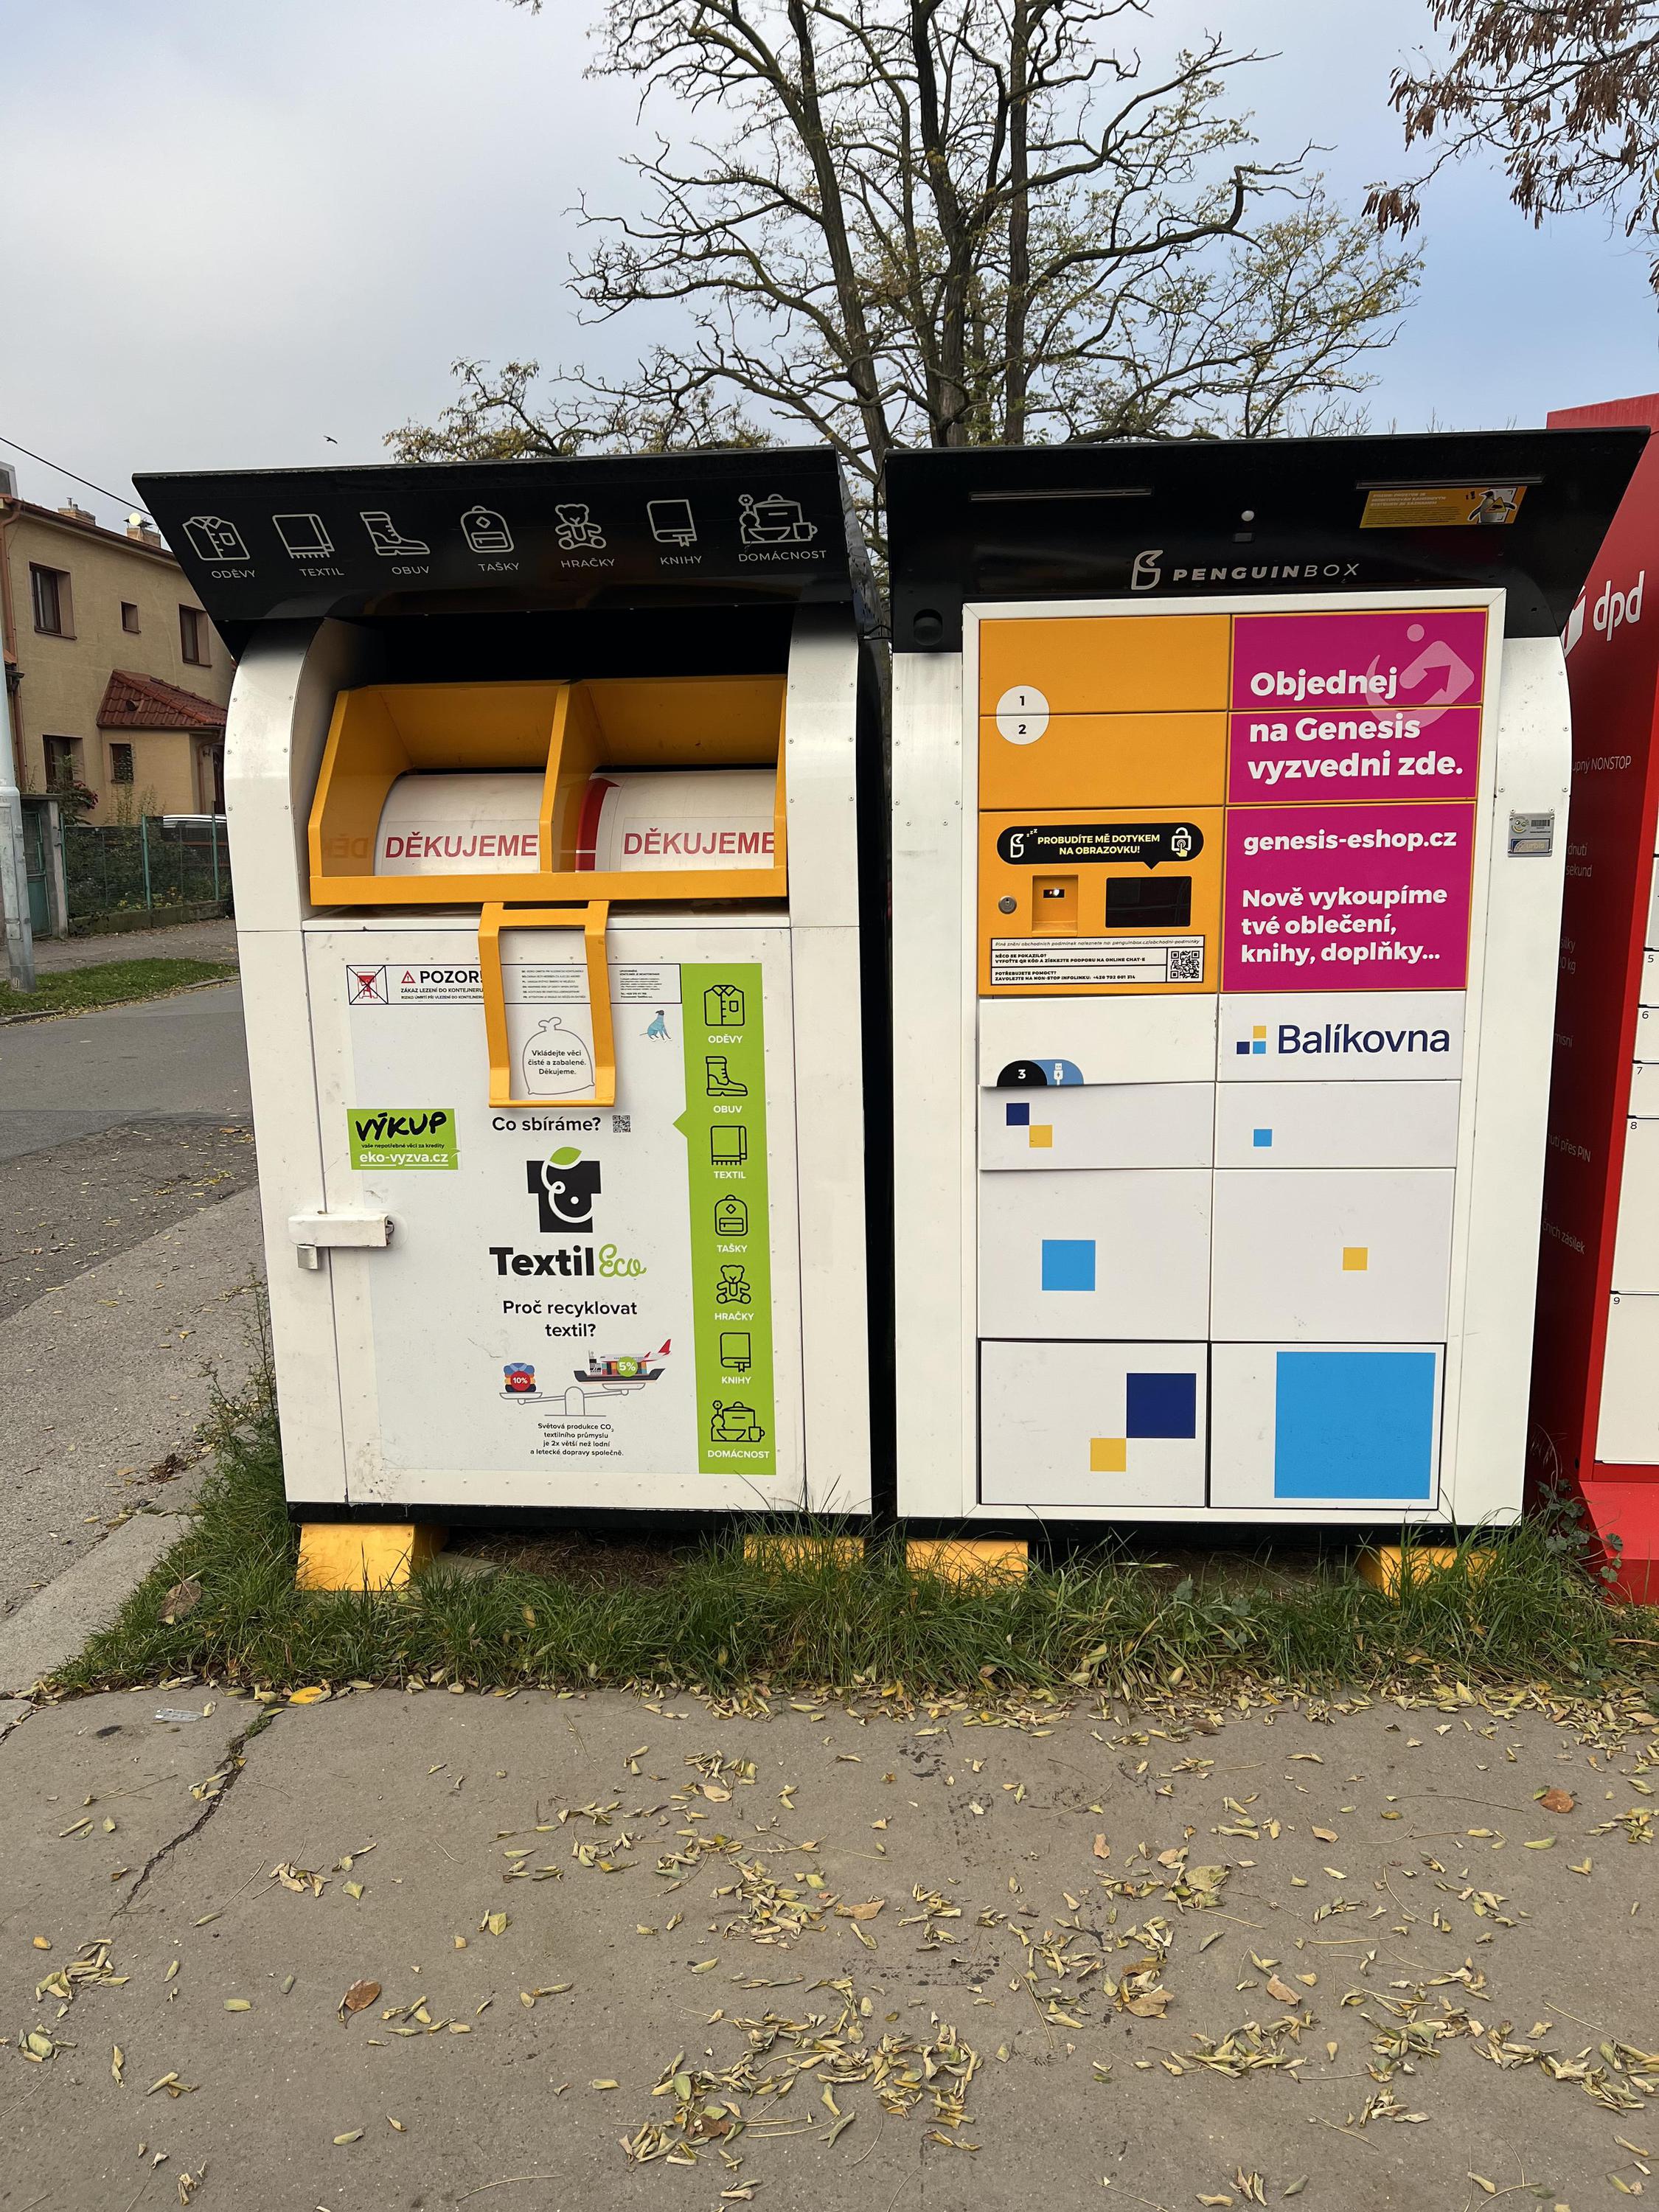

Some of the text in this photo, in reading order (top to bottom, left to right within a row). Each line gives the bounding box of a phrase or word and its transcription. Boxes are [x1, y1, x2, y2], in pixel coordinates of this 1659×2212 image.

[660, 555, 703, 566] KNIHY
[738, 548, 827, 563] DOMÁCNOST
[478, 560, 519, 572] TAŠKY
[560, 557, 616, 569] HRAČKY
[211, 568, 256, 579] ODĚVY
[299, 567, 344, 577] TEXTIL
[392, 566, 430, 575] OBUV
[1173, 563, 1360, 582] PENGUINBOX
[1593, 570, 1645, 641] dpd
[1251, 666, 1397, 701] Objednej
[1020, 695, 1025, 706] 1
[1018, 724, 1026, 734] 2
[1250, 712, 1421, 742] na Genesis
[1248, 750, 1463, 785] vyzvedni zde.
[1591, 756, 1632, 771] NONSTOP
[385, 830, 538, 858] DĚKUJEME
[624, 827, 774, 855] DĚKUJEME
[1037, 833, 1161, 845] PROBUDÍTE MĚ DOTYKEM
[1244, 829, 1457, 856] genesis-eshop.cz
[1059, 846, 1140, 855] NA OBRAZOVKU!
[1242, 885, 1447, 910] Nově vykoupíme
[1242, 914, 1397, 935] tvé oblečení,
[1241, 941, 1440, 967] knihy, doplňky...
[1648, 955, 1654, 963] 5
[1642, 1010, 1649, 1020] 6
[708, 1034, 742, 1044] ODĚVY
[1278, 1023, 1450, 1054] Balíkovna
[1018, 1069, 1026, 1079] 3
[1637, 1067, 1643, 1075] 7
[713, 1105, 742, 1113] OBUV
[355, 1111, 447, 1141] VÝKUP
[492, 1116, 601, 1131] Co sbíráme?
[1630, 1121, 1637, 1130] 8
[359, 1151, 448, 1165] eko-vyzva.cz
[1577, 1146, 1591, 1163] PIN
[714, 1171, 746, 1179] TEXTIL
[717, 1244, 748, 1253] TAŠKY
[1613, 1297, 1620, 1305] 9
[503, 1300, 638, 1318] Proč recyklovat
[714, 1311, 754, 1321] HRAČKY
[545, 1324, 597, 1338] textil?
[619, 1361, 636, 1371] 5%
[721, 1377, 751, 1385] KNIHY
[708, 1448, 770, 1459] DOMÁCNOST
